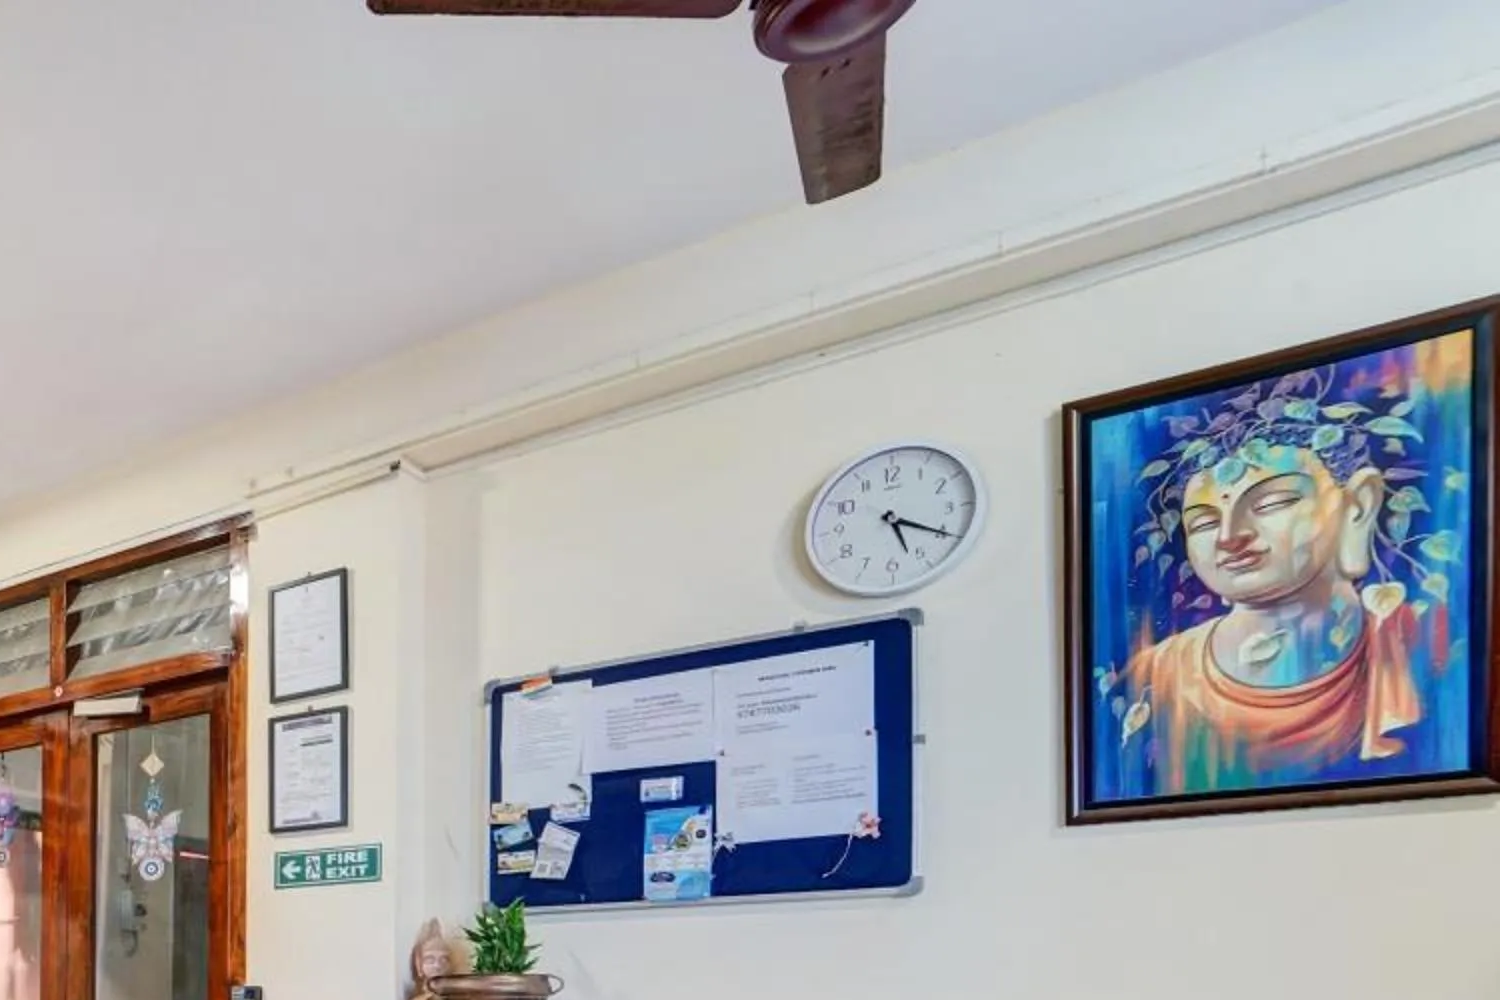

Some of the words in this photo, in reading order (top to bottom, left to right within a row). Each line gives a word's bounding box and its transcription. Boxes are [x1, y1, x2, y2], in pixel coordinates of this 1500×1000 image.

[884, 466, 901, 484] 12
[861, 480, 871, 493] 11
[935, 478, 947, 495] 2
[837, 500, 855, 515] 10
[944, 502, 954, 515] 3
[833, 523, 845, 538] 9
[839, 544, 853, 559] 8
[915, 547, 925, 559] 5
[885, 557, 899, 572] 6
[326, 850, 368, 865] FIRE
[325, 864, 369, 879] EXIT
